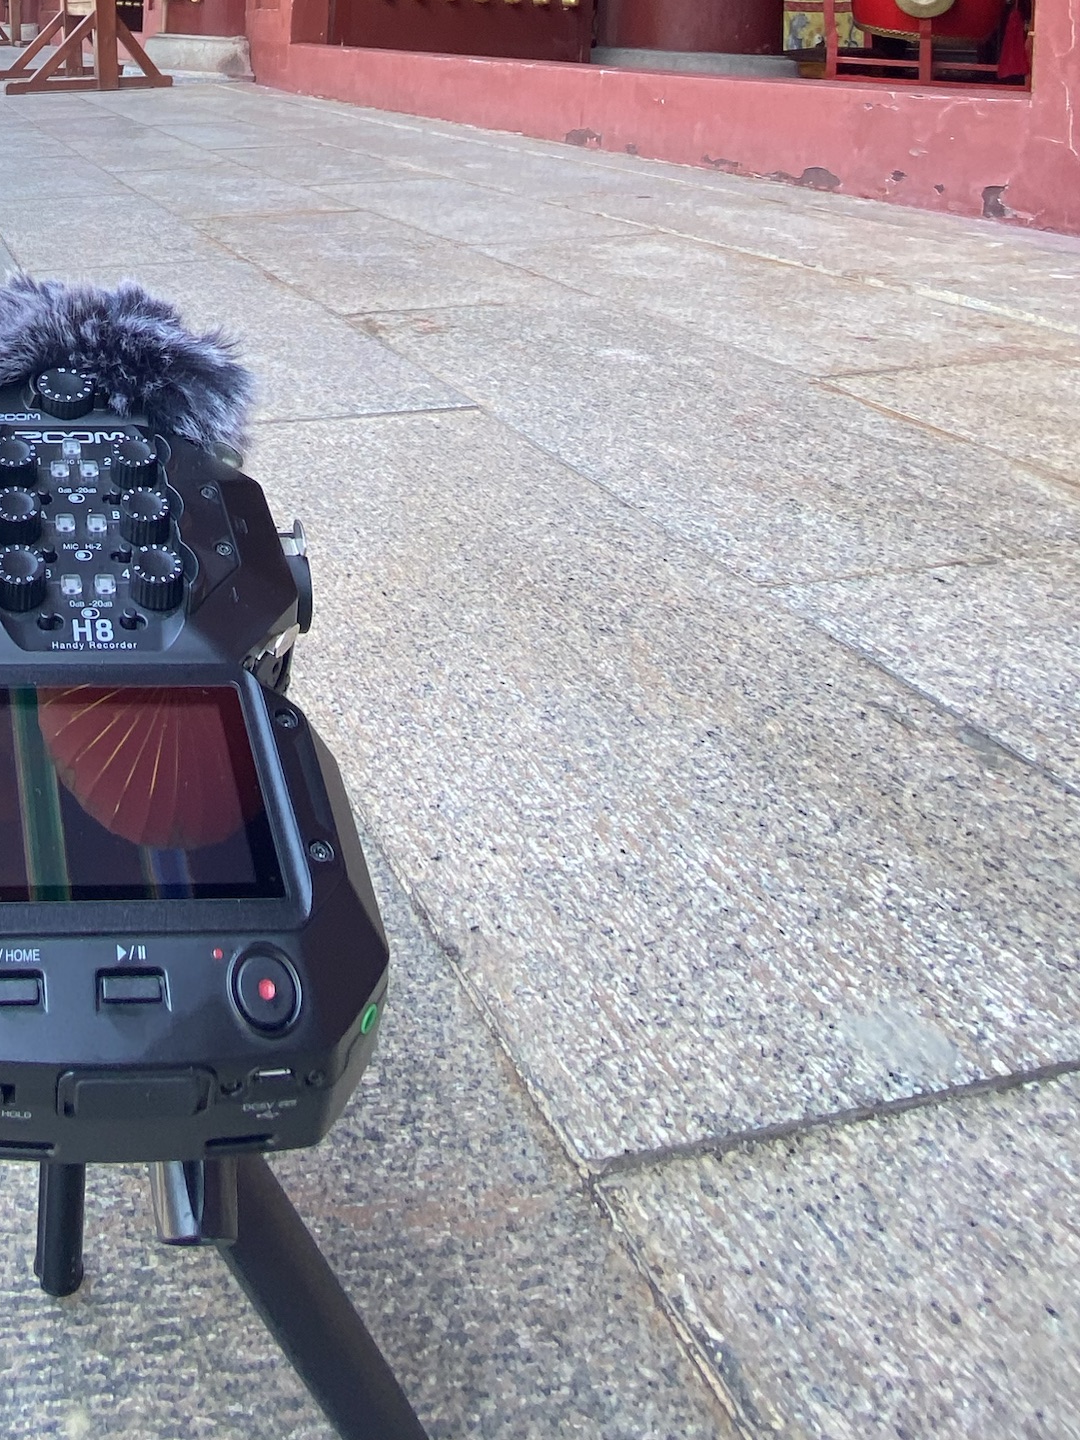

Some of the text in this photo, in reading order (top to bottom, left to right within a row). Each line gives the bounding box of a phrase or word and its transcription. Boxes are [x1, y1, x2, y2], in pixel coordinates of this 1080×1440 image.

[14, 431, 125, 444] ZOOM
[104, 457, 112, 466] 2
[112, 510, 121, 520] B
[121, 568, 130, 579] 4
[69, 600, 85, 608] 0dB
[72, 619, 114, 642] H8
[51, 641, 138, 650] Handy Recorder
[1, 1109, 32, 1119] HOLD
